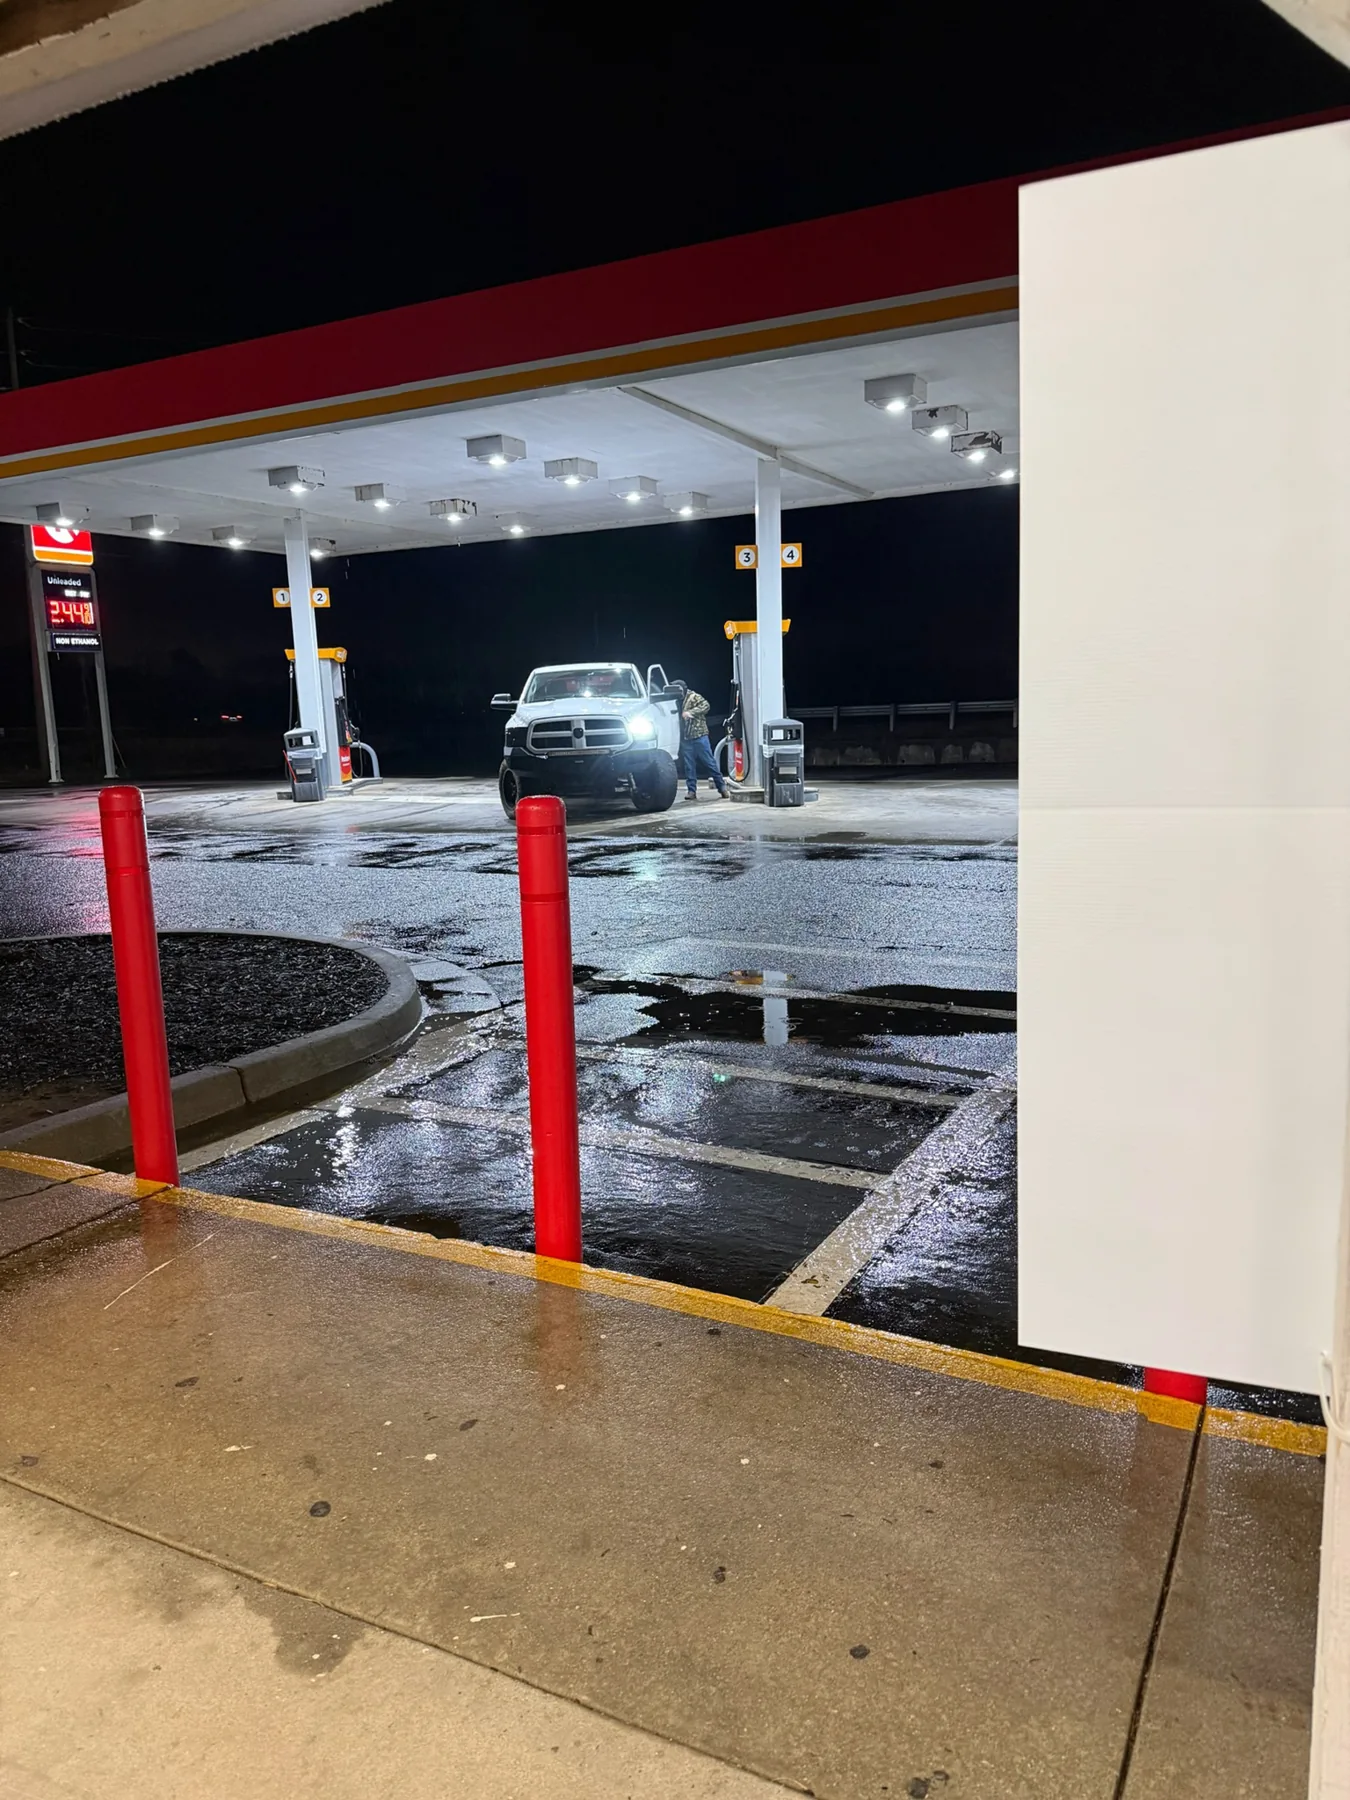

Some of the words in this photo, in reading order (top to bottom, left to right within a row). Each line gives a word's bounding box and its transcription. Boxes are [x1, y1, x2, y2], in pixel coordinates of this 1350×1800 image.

[743, 552, 751, 562] 3
[786, 550, 795, 560] 4
[47, 576, 82, 586] Unleaded
[280, 593, 285, 601] 1
[316, 593, 324, 602] 2
[55, 637, 70, 645] NON
[71, 638, 99, 646] ETHANOL
